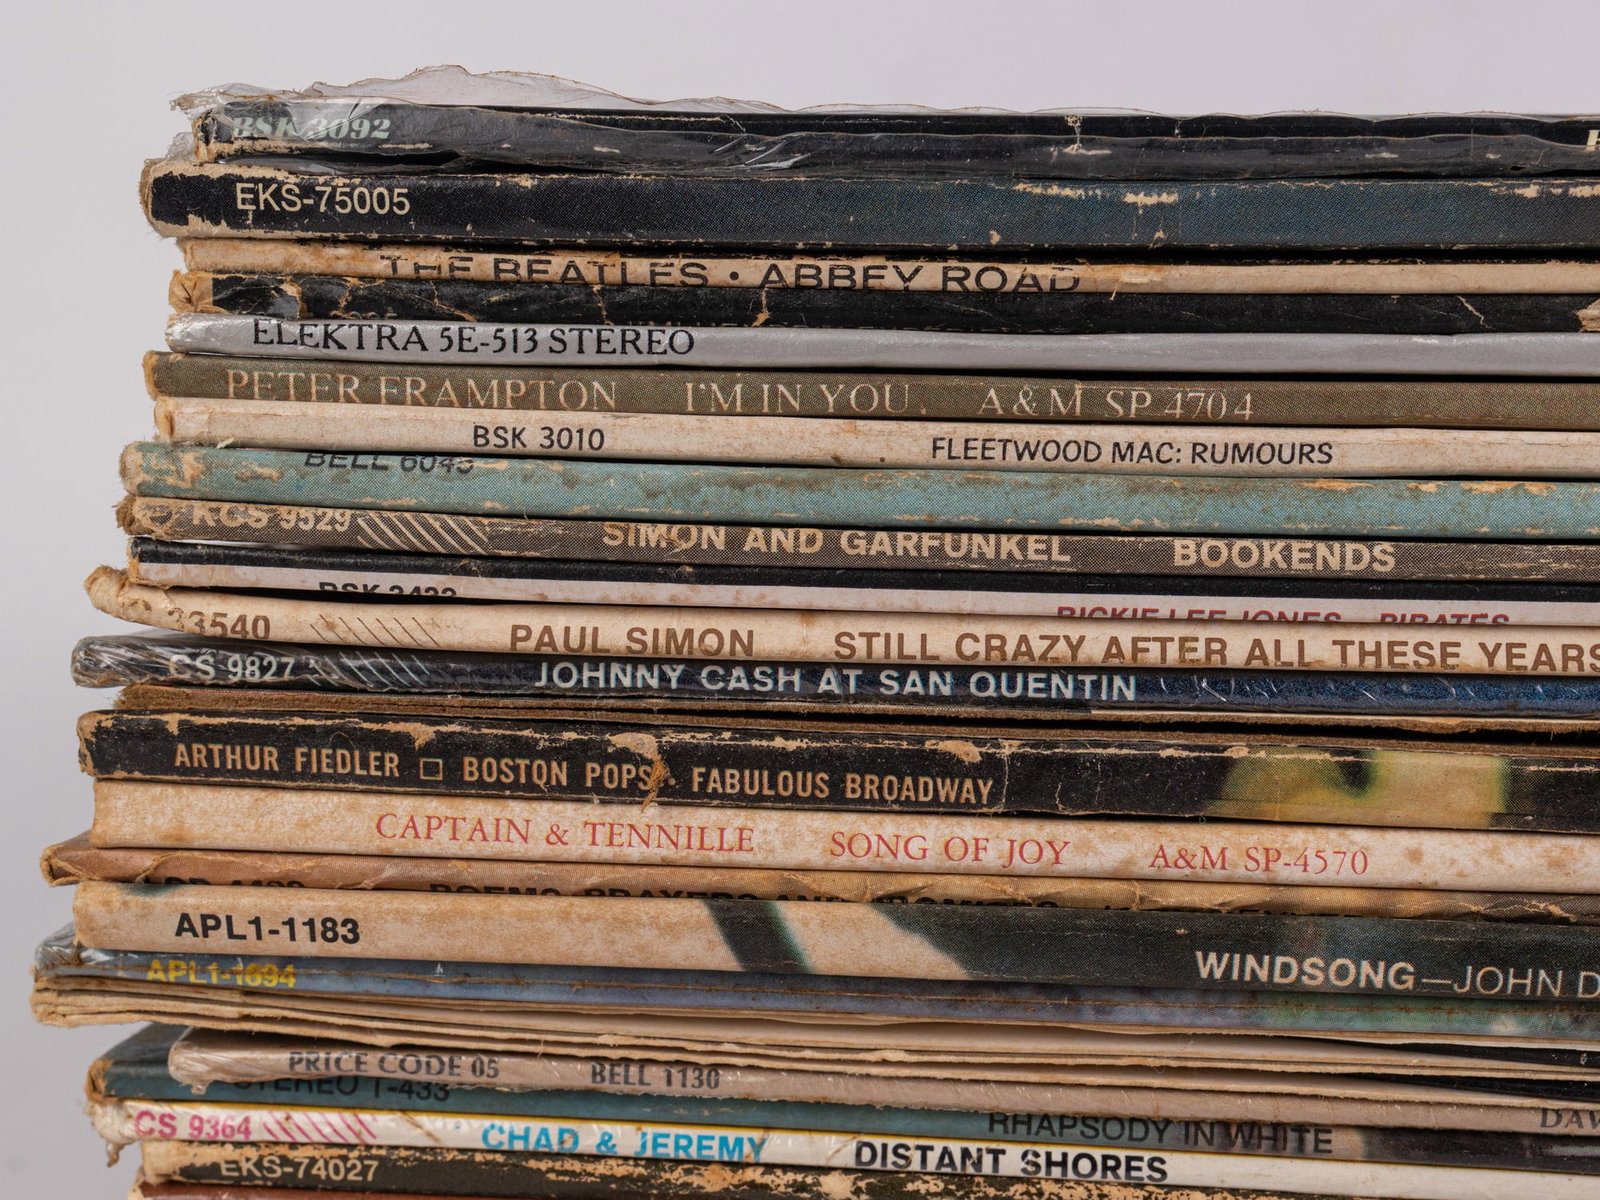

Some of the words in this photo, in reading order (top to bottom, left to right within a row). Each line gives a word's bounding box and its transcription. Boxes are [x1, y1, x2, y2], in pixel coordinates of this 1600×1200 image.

[306, 118, 391, 140] 3092
[236, 182, 411, 216] EKS-75005
[760, 263, 924, 292] ABBEY
[942, 265, 1081, 294] ROAD
[253, 318, 429, 351] ELEKTRA
[440, 326, 538, 354] 5E-513
[549, 327, 696, 355] STEREO
[226, 368, 361, 402] PETER
[379, 373, 617, 410] FRAMPTON
[684, 382, 743, 412] I'M
[762, 383, 803, 413] IN
[977, 387, 1004, 415] A
[1011, 387, 1039, 416] &
[1049, 387, 1083, 417] M
[1105, 389, 1151, 418] SP
[473, 424, 527, 449] BSK
[539, 426, 606, 451] 3010
[931, 437, 1101, 463] FLEETWOOD
[1112, 440, 1182, 465] MAC:
[1191, 442, 1333, 466] RUMOURS
[602, 520, 726, 552] SIMON
[743, 526, 824, 555] AND
[839, 530, 1072, 562] GARFUNKEL
[1173, 538, 1396, 573] BOOKENDS
[510, 624, 612, 655] PAUL
[625, 627, 756, 657] SIMON
[833, 631, 939, 661] STILL
[954, 633, 1086, 663] CRAZY
[1100, 635, 1229, 666] AFTER
[1245, 638, 1316, 668] ALL
[1331, 639, 1462, 670] THESE
[1478, 641, 1600, 673] YEARS
[169, 654, 216, 681] CS
[227, 654, 296, 682] 9827
[533, 661, 685, 691] JOHNNY
[700, 665, 801, 693] CASH
[816, 668, 863, 695] AT
[879, 670, 955, 697] SAN
[968, 671, 1137, 701] QUENTIN
[174, 742, 279, 772] ARTHUR
[294, 747, 400, 778] FIEDLER
[463, 757, 568, 788] BOSTON
[691, 767, 831, 799] FABULOUS
[845, 773, 994, 804] BROADWAY
[376, 812, 531, 844] CAPTAIN
[545, 824, 569, 846] &
[583, 821, 755, 853] TENNILLE
[829, 831, 929, 861] SONG
[944, 835, 990, 863] OF
[1001, 837, 1071, 869] JOY
[1148, 843, 1229, 871] A&M
[1244, 846, 1369, 876] SP-4570
[175, 912, 361, 944] APL1-1183
[146, 959, 297, 988] APL1-1694
[288, 1050, 369, 1073] PRICE
[378, 1052, 462, 1077] CODE
[470, 1054, 500, 1079] 05
[591, 1062, 652, 1087] BELL
[662, 1065, 720, 1090] 1130
[133, 1109, 178, 1139] CS
[188, 1113, 253, 1141] 9364
[987, 1113, 1174, 1145] RHAPSODY
[1183, 1121, 1216, 1147] IN
[1228, 1125, 1333, 1154] WHITE
[482, 1123, 581, 1154] CHAD
[595, 1133, 619, 1156] &
[634, 1131, 769, 1163] JEREMY
[220, 1156, 380, 1182] EKS-74027
[854, 1139, 1006, 1175] DISTANT
[1020, 1148, 1169, 1183] SHORES
